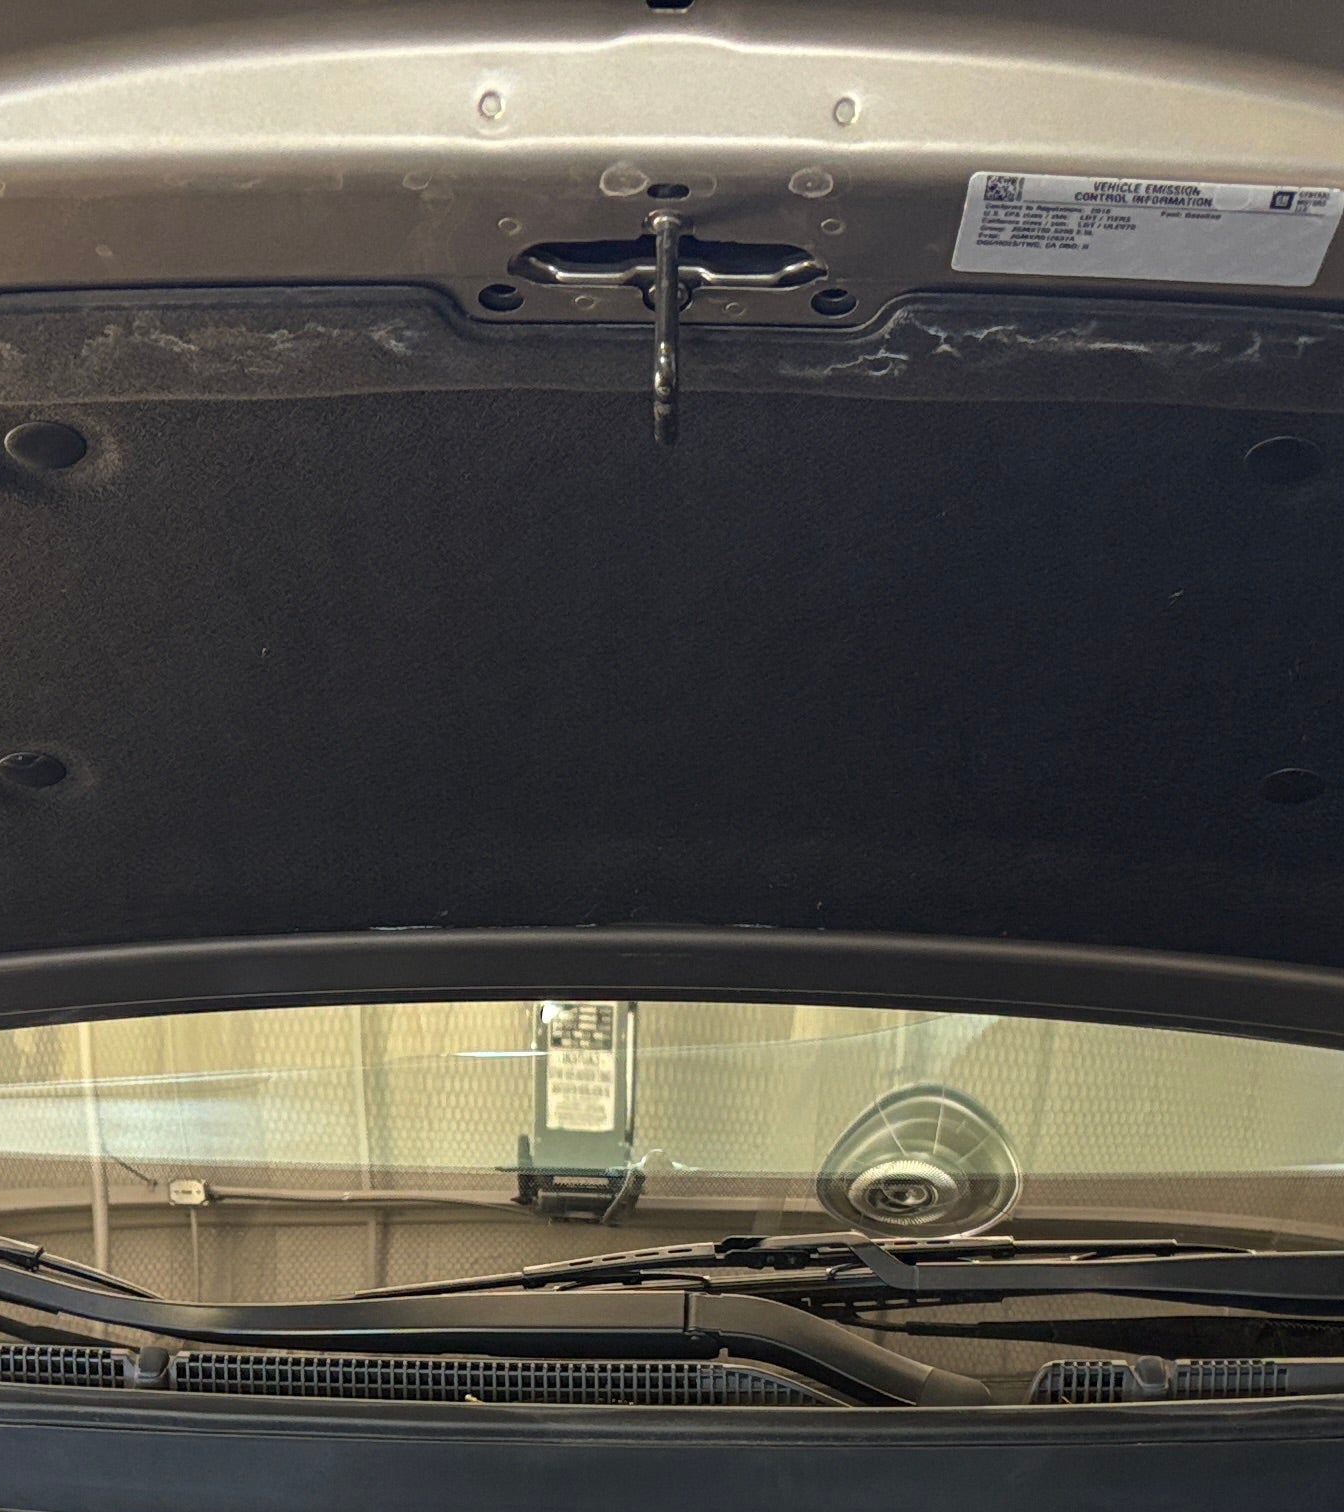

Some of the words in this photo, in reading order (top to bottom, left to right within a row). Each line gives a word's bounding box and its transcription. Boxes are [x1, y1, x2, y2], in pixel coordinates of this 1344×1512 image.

[1093, 181, 1142, 194] VEHICLE
[1144, 183, 1201, 197] EMISSION
[1074, 191, 1128, 204] CONTROL
[1132, 195, 1213, 208] INFORMATION
